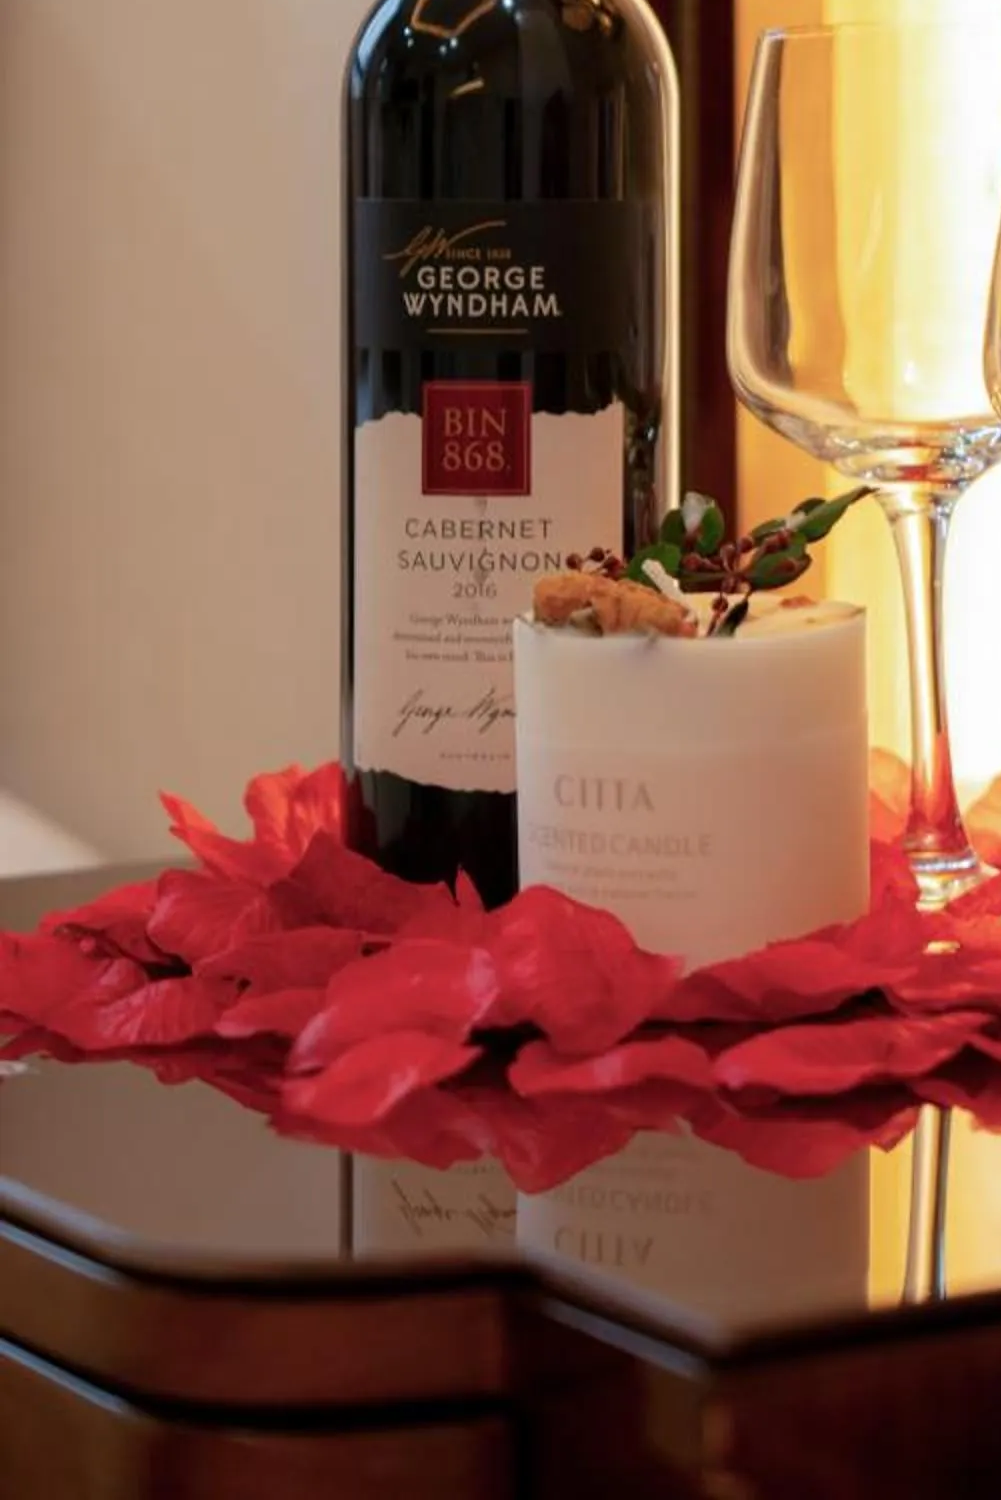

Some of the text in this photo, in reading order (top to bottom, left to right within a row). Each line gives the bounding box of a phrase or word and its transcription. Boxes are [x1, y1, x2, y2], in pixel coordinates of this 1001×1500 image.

[416, 265, 546, 291] GEORGE
[402, 292, 561, 318] WYNDHAM
[443, 407, 506, 438] BIN
[442, 440, 505, 472] 868
[404, 517, 553, 541] CABERNET
[397, 549, 561, 573] SAUVIGNON
[452, 582, 498, 599] 2016
[553, 773, 656, 813] CITTA
